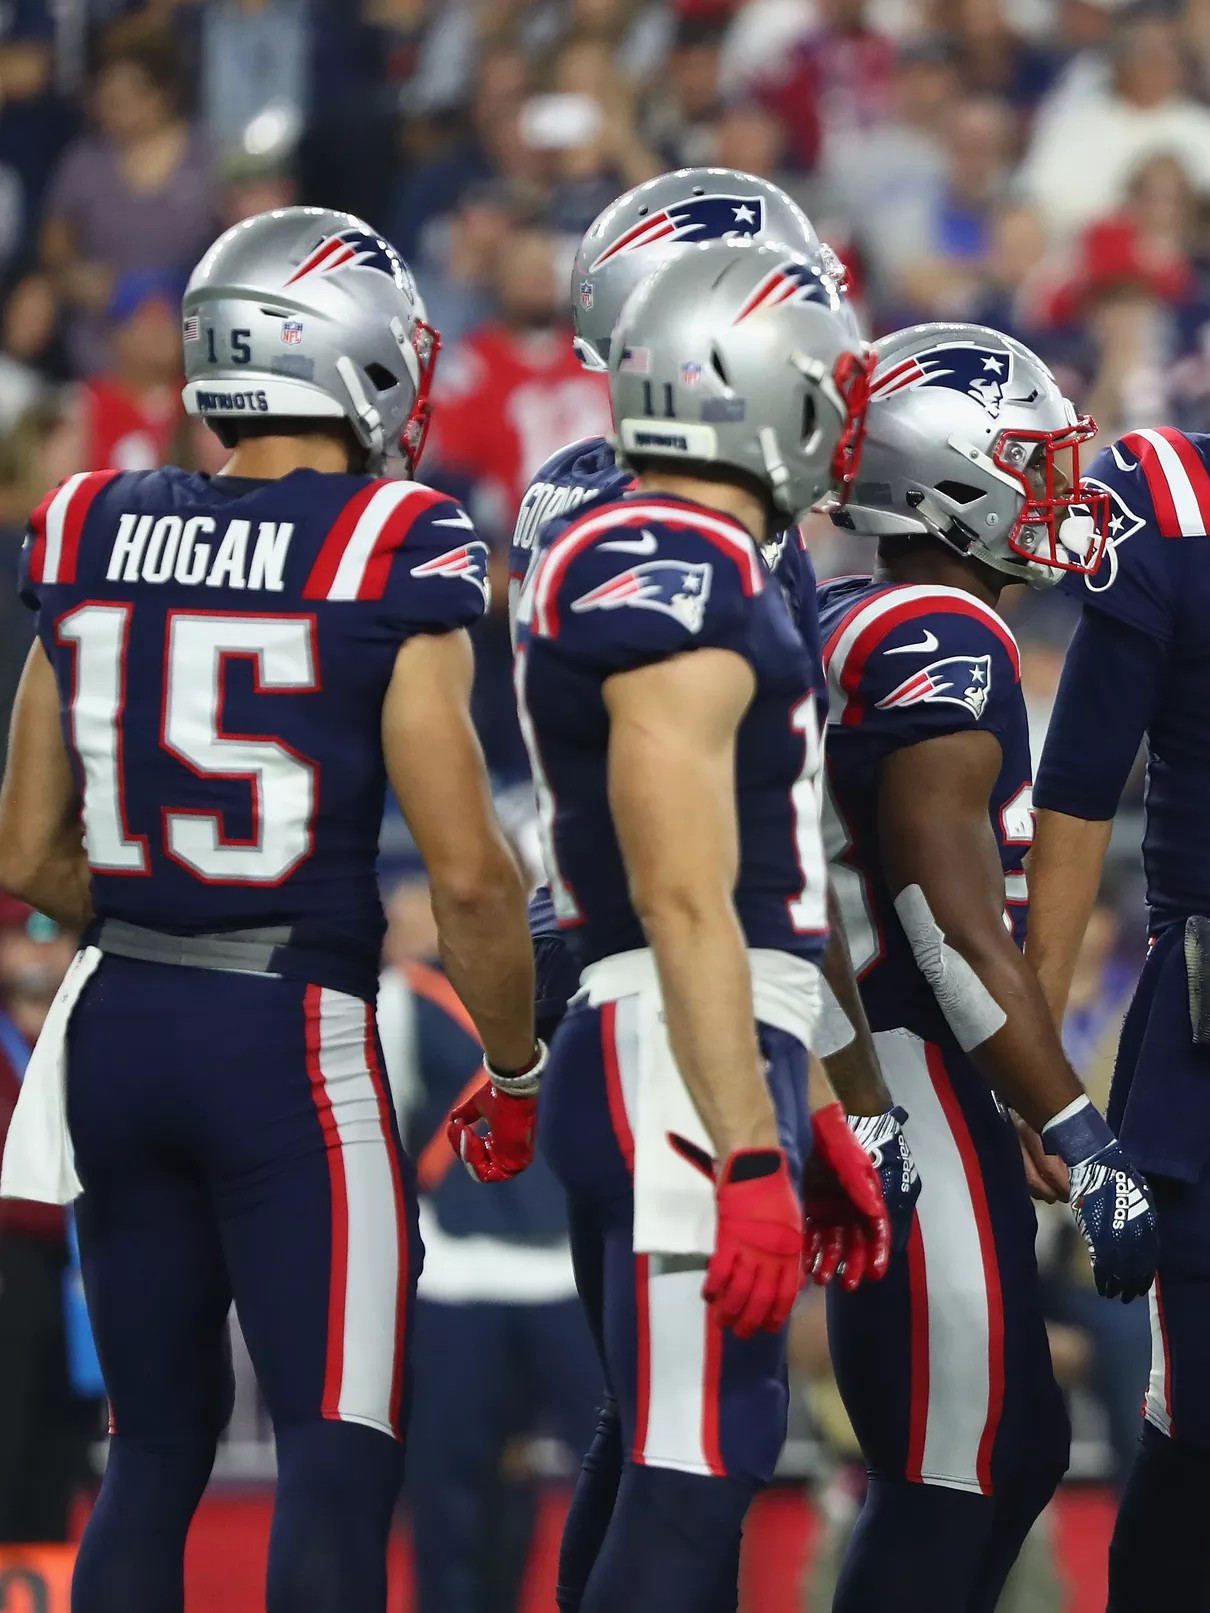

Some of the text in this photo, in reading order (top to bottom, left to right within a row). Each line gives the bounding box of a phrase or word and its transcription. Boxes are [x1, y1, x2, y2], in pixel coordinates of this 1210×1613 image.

[207, 328, 251, 363] 15
[196, 389, 268, 412] PATRIOTS
[106, 513, 294, 592] HOGAN
[55, 600, 323, 888] 15
[1112, 1170, 1130, 1231] adidas
